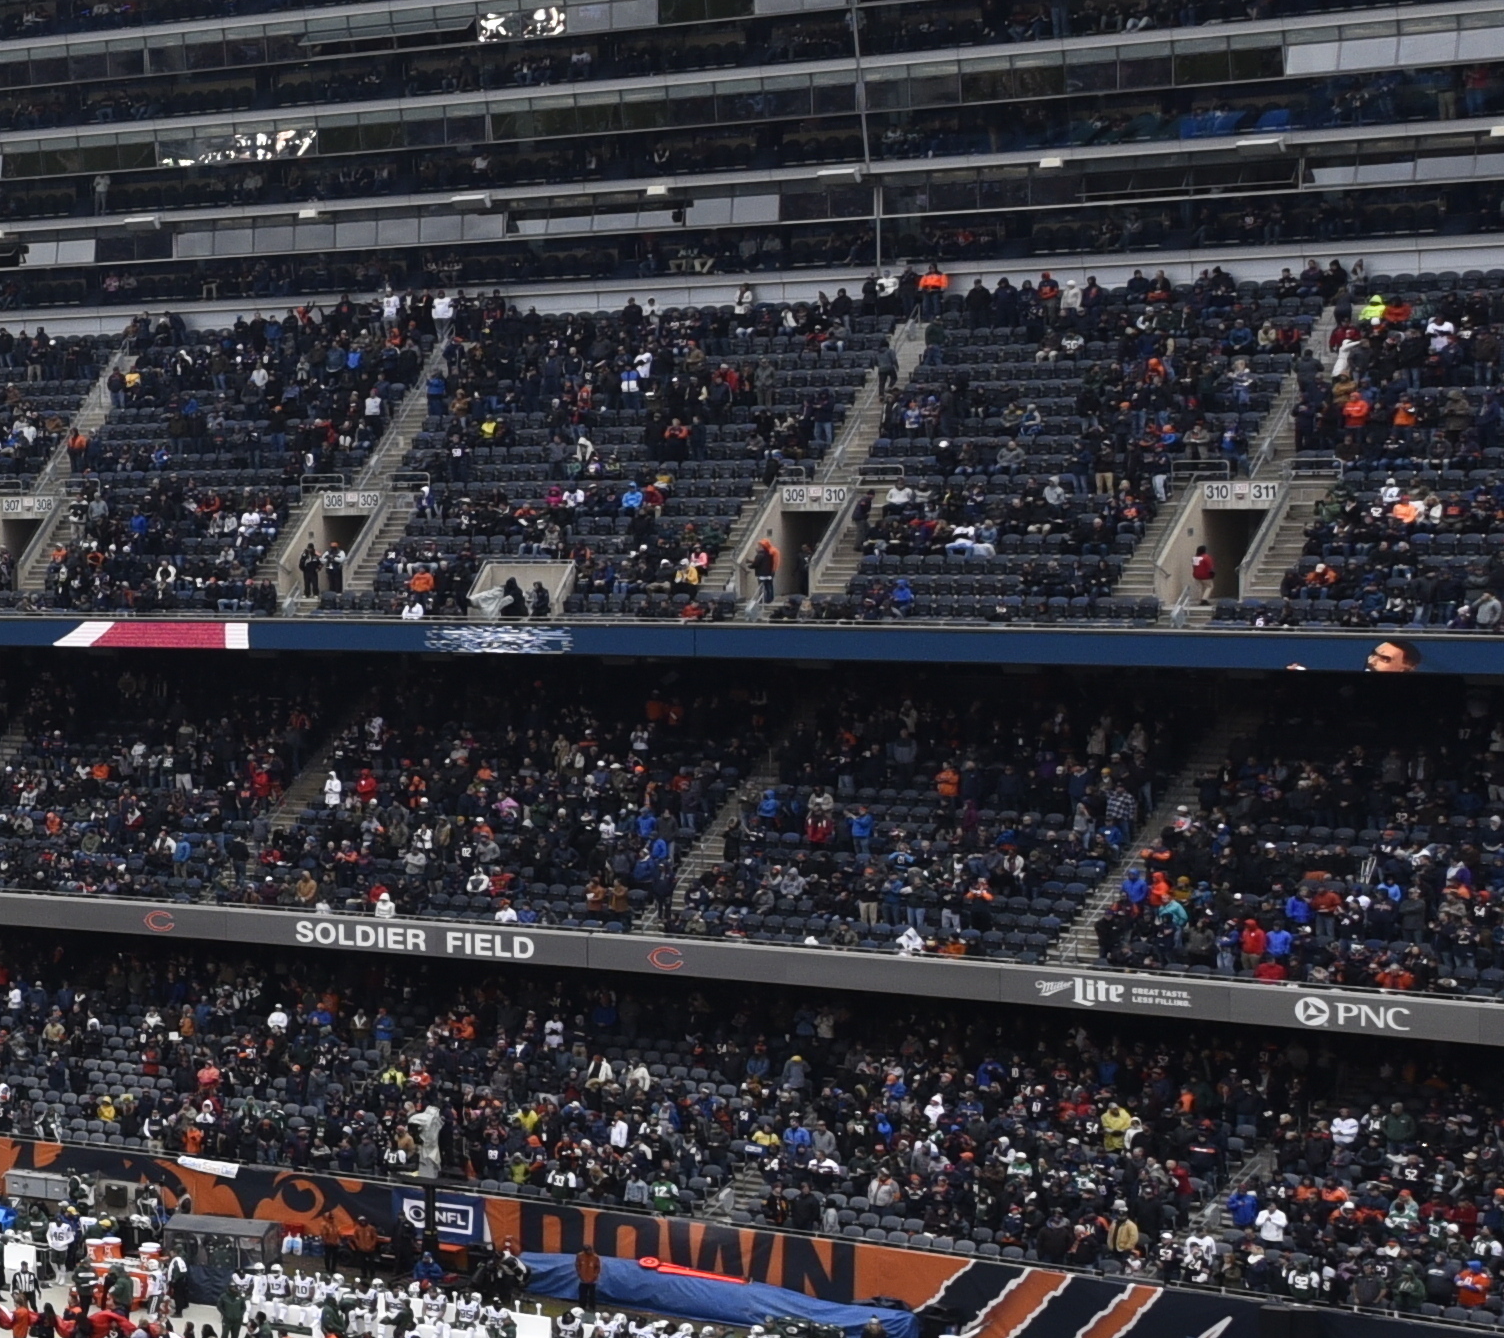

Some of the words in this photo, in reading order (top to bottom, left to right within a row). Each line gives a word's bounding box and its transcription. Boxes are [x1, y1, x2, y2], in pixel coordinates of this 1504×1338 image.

[784, 488, 805, 502] 309
[824, 487, 846, 502] 310
[1205, 484, 1229, 499] 310
[1252, 483, 1277, 499] 311
[4, 499, 20, 511] 307
[35, 498, 53, 511] 308
[325, 494, 343, 507] 308
[360, 493, 379, 507] 309
[295, 920, 426, 952] SOLDIER
[445, 930, 534, 958] FIELD
[1072, 975, 1125, 1007] Lite
[1336, 1001, 1411, 1031] PNC
[654, 1186, 670, 1198] 12
[435, 1210, 467, 1226] NFL
